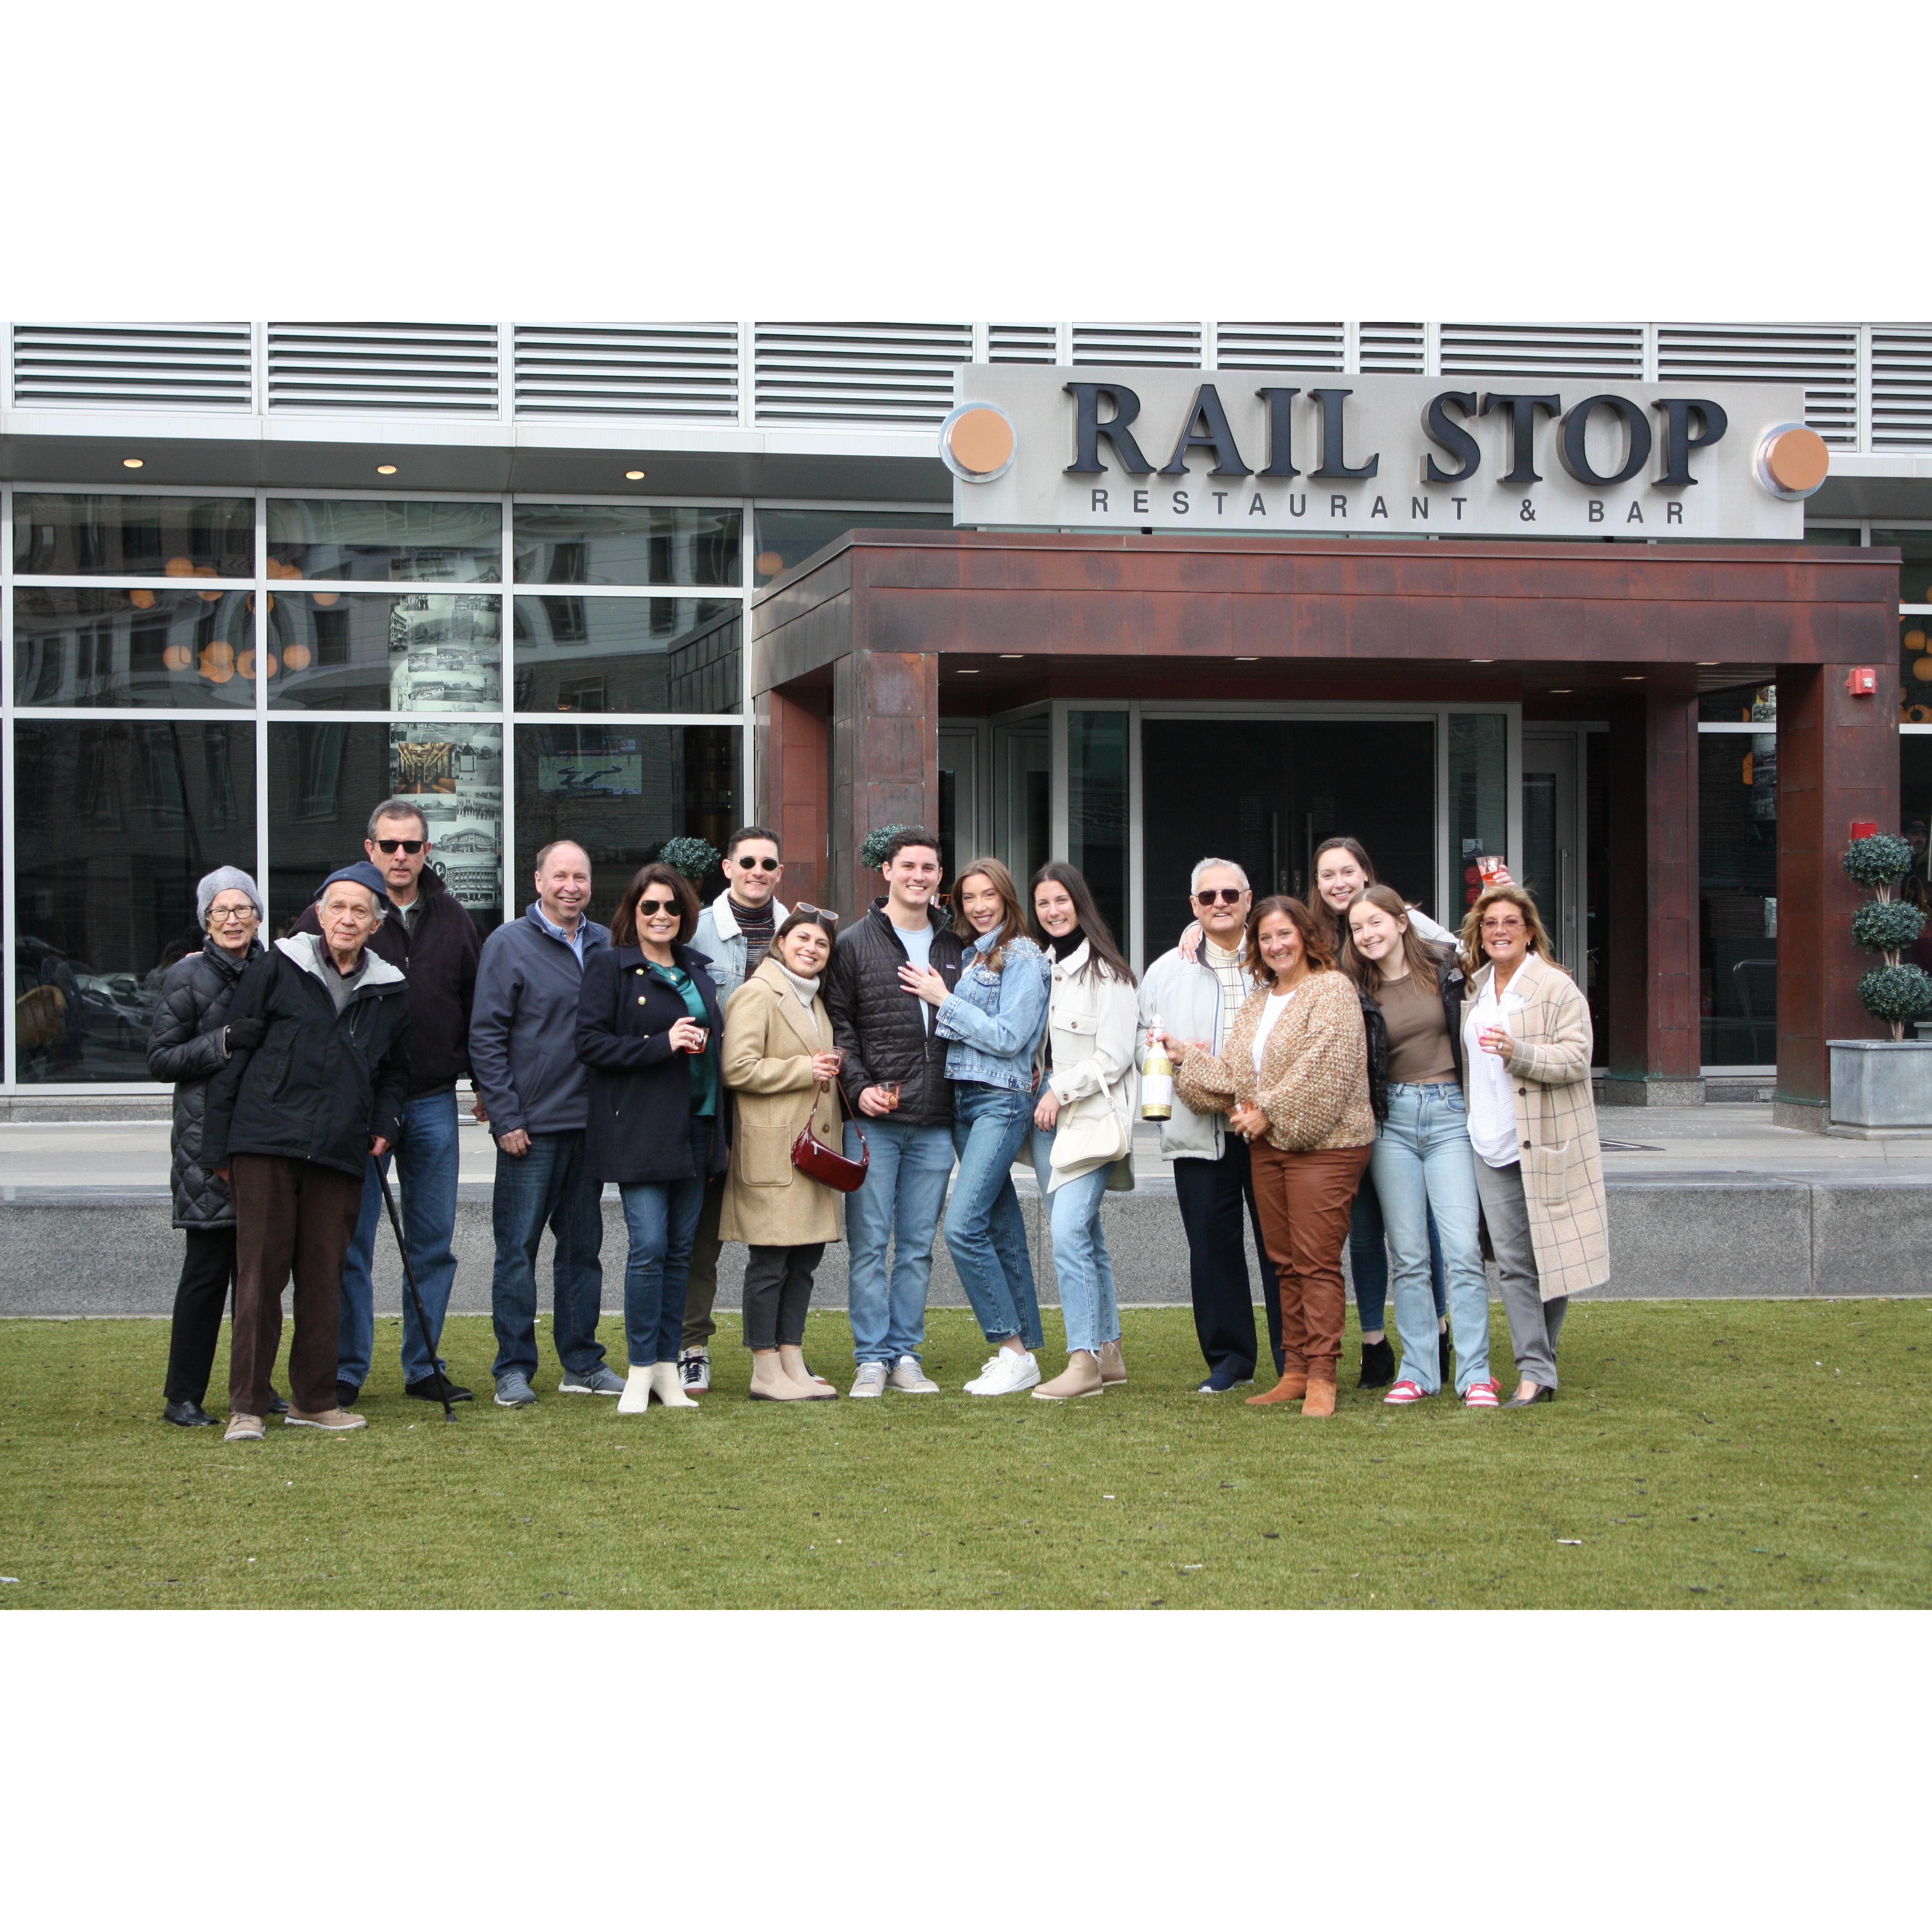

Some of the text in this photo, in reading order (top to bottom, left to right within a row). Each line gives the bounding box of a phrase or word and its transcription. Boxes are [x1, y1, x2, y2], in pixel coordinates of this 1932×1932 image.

[1061, 382, 1728, 487] RAIL STOP
[1092, 489, 1683, 524] RESTAURANT & BAR
